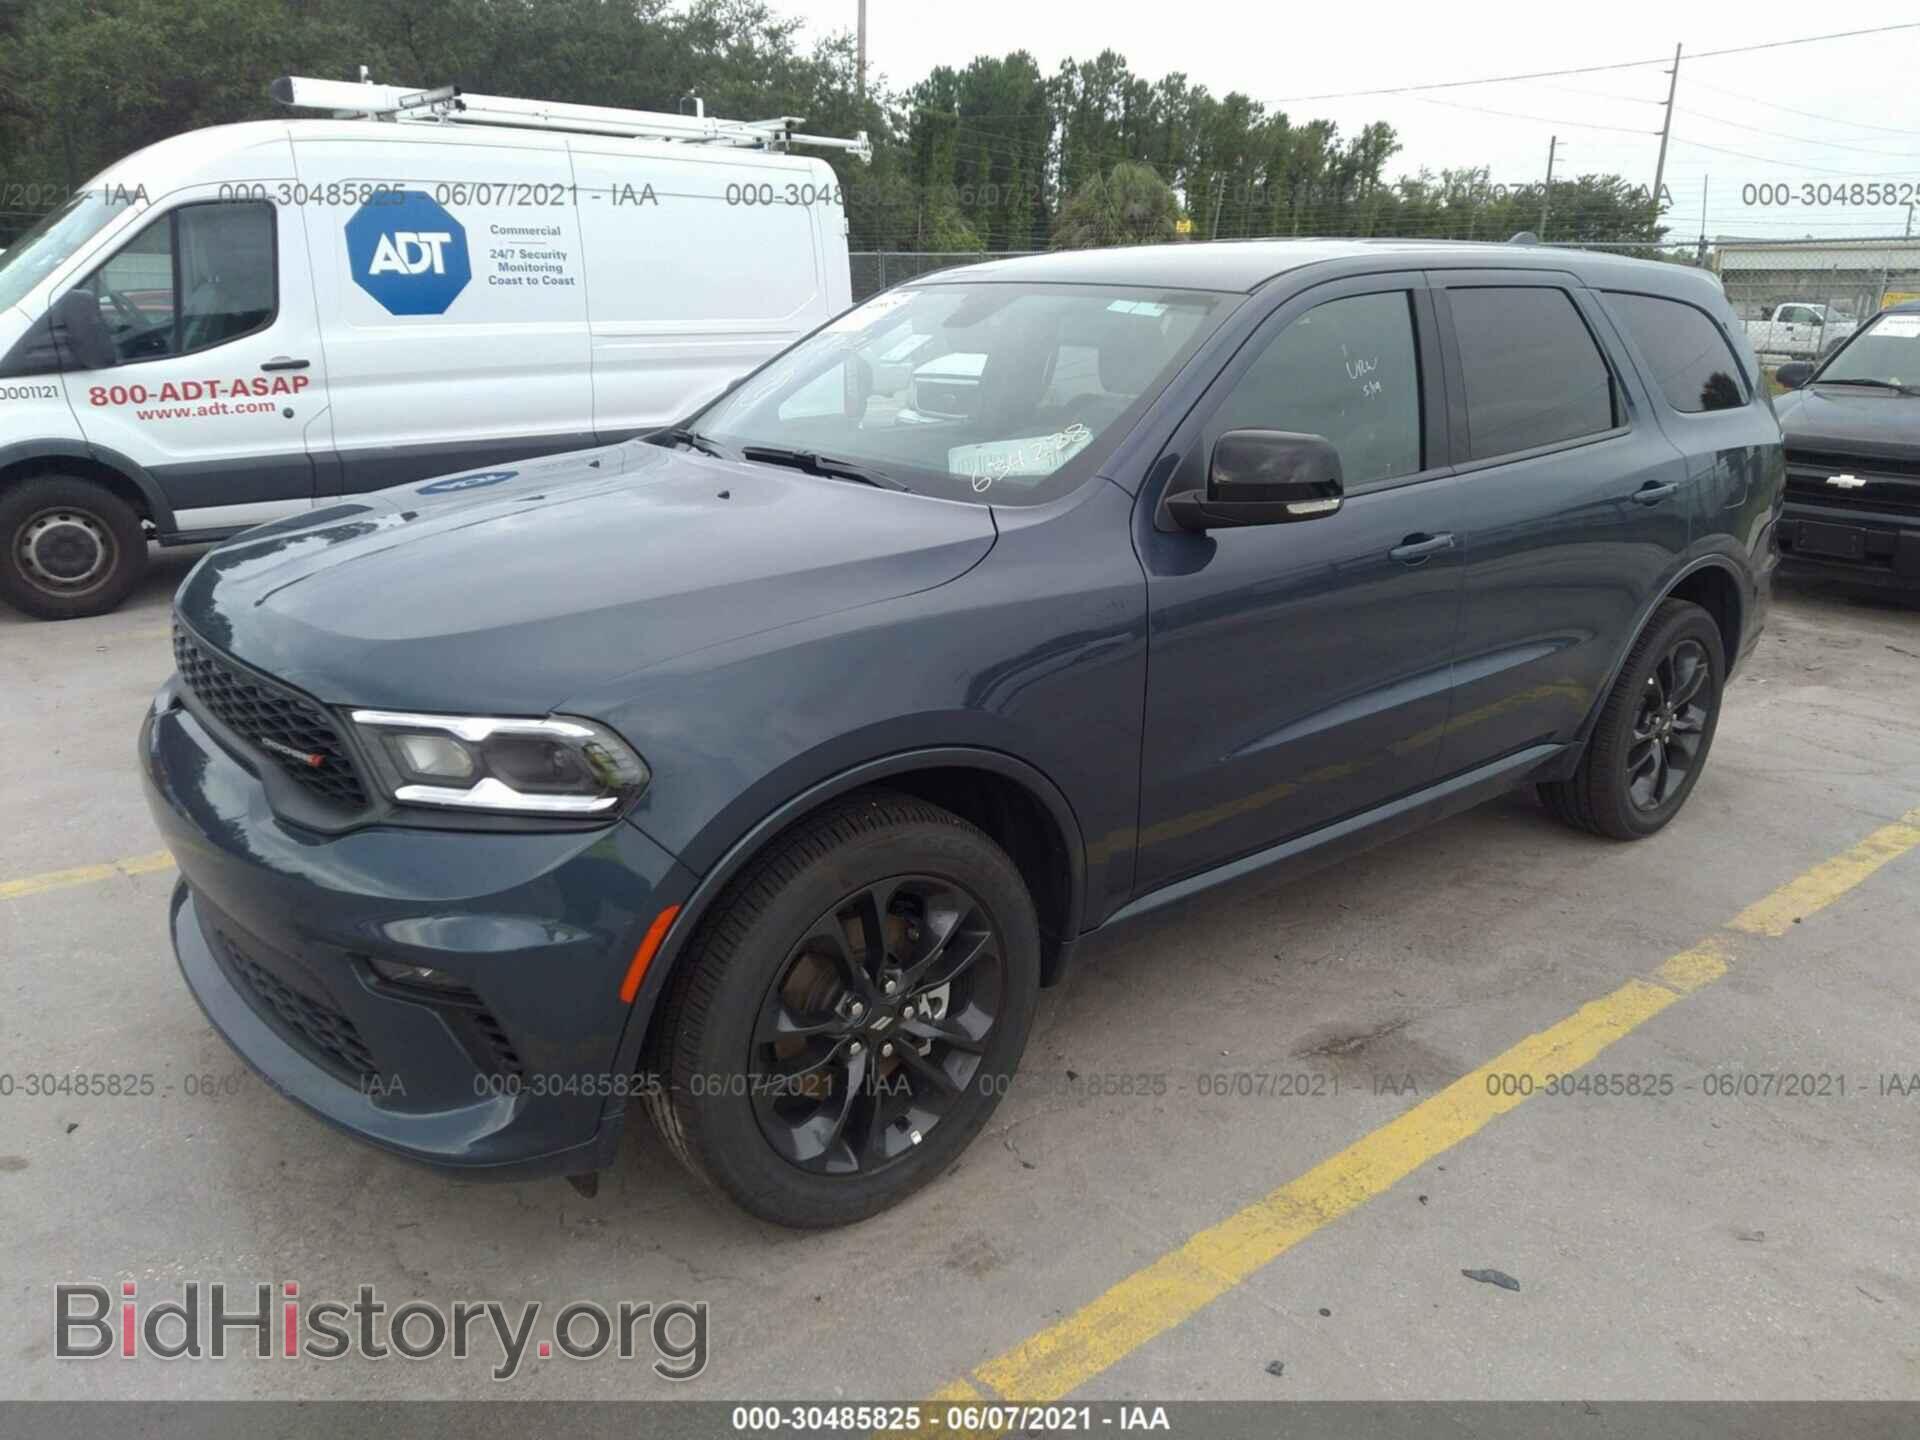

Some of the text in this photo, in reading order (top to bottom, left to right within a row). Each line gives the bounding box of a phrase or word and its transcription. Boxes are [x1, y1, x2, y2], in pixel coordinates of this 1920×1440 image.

[489, 224, 561, 236] Commercial
[368, 231, 452, 275] ADT
[489, 248, 567, 262] 24/7 Security
[498, 261, 564, 274] Monitoring
[488, 275, 576, 286] Coast to Coast
[88, 375, 310, 407] 800-ADT-ASAP
[136, 400, 276, 421] www.adt.com
